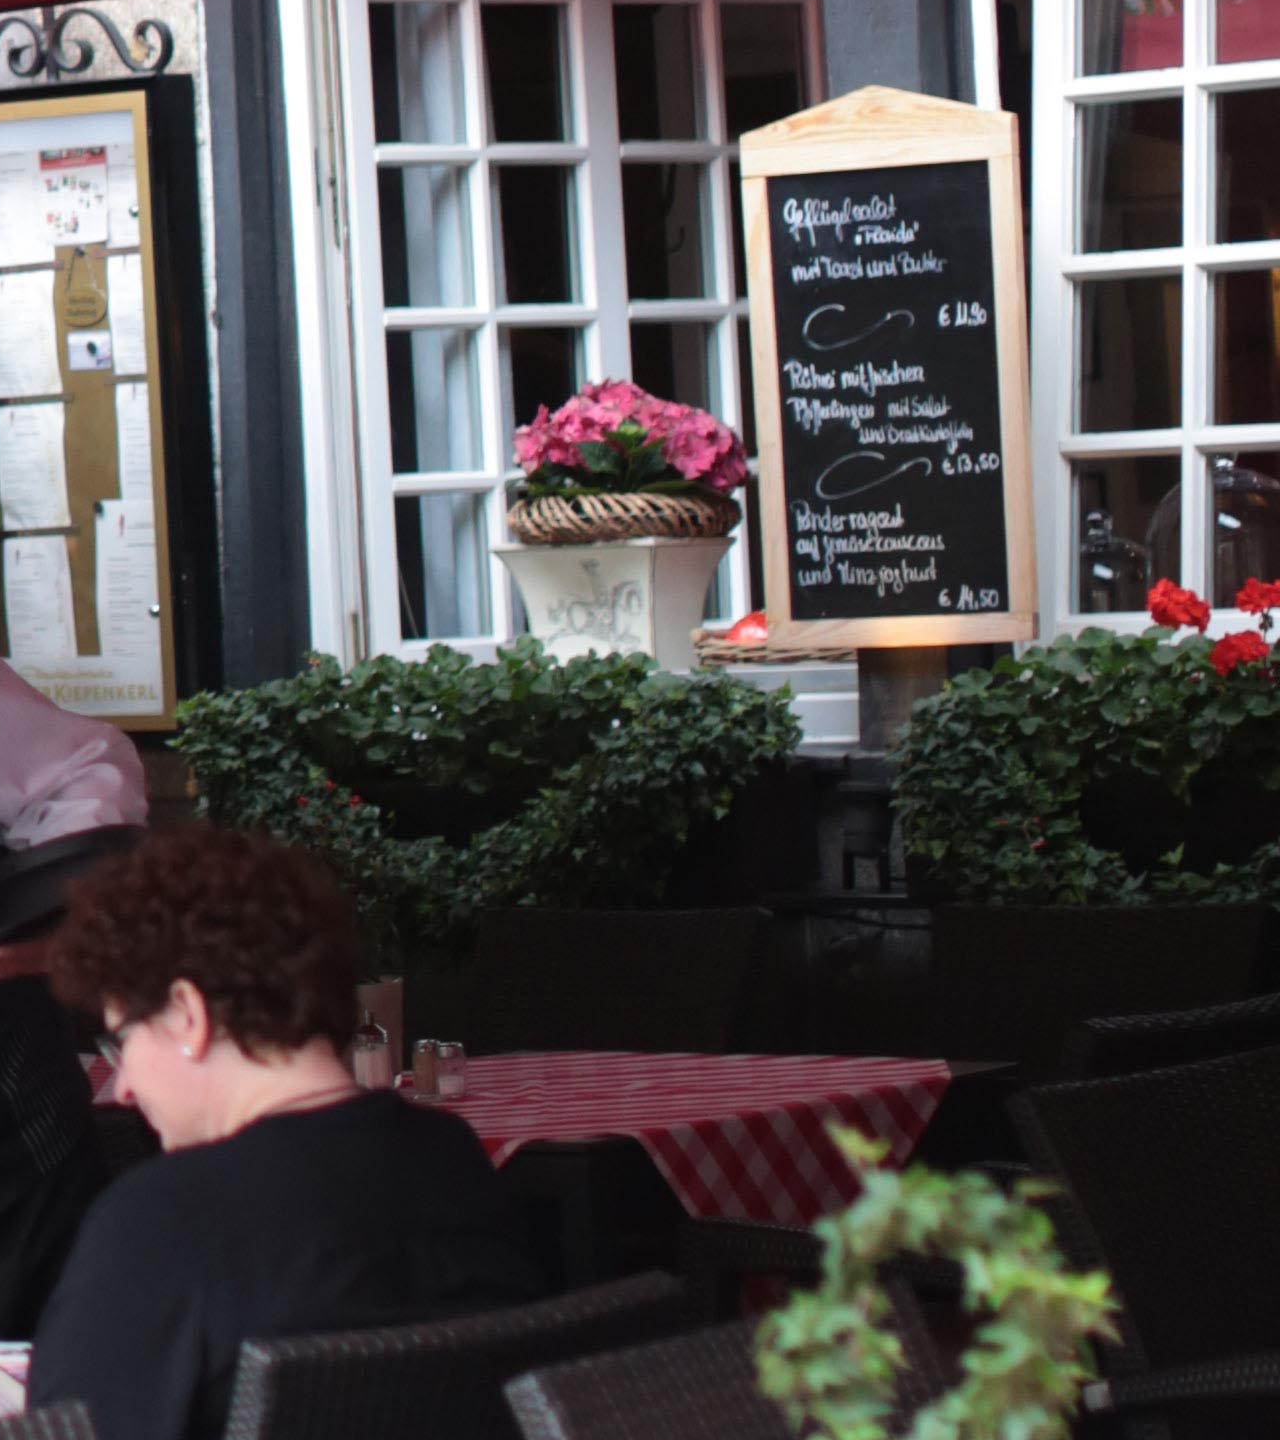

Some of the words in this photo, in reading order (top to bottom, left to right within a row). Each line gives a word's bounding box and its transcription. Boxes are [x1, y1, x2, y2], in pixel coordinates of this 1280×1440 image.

[791, 257, 821, 285] mit
[866, 253, 898, 279] und
[840, 361, 867, 390] mit
[888, 396, 911, 418] mit
[797, 563, 833, 588] und
